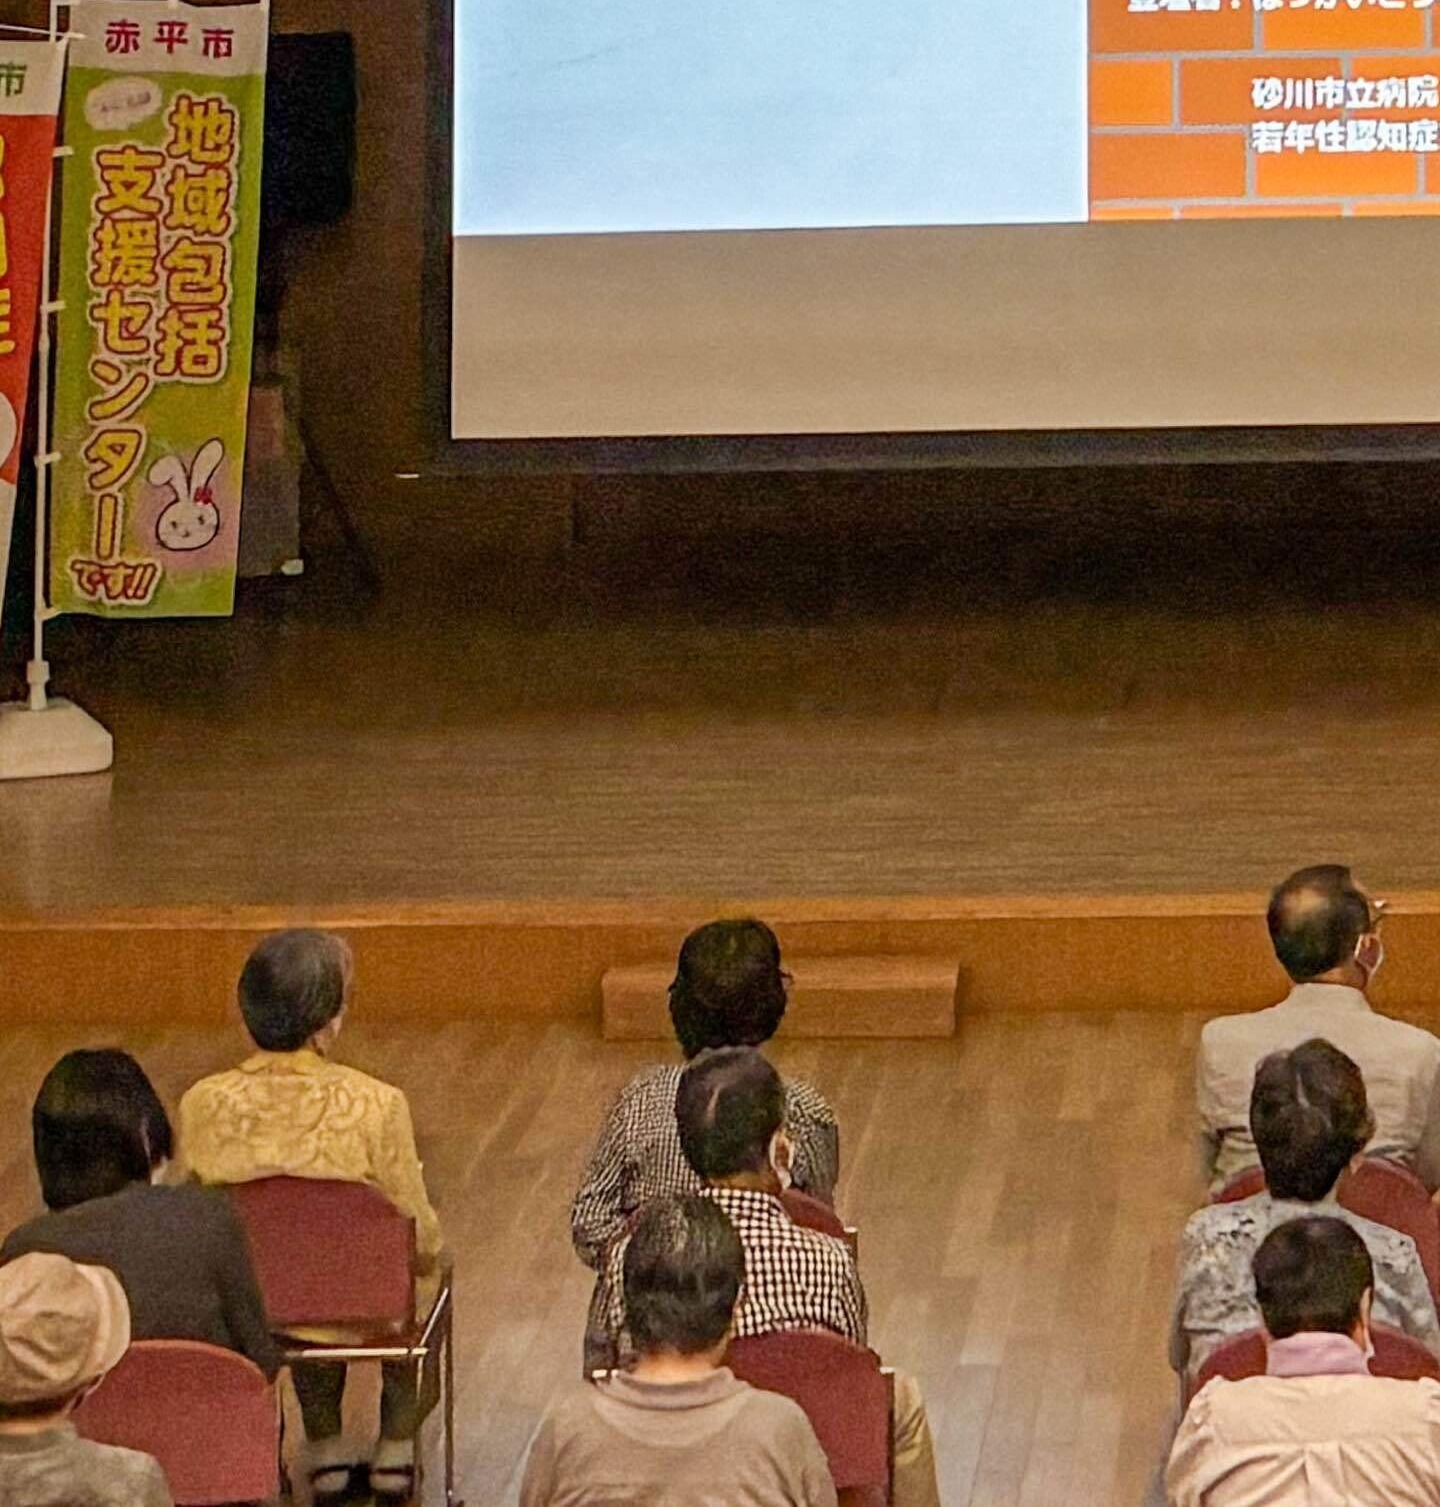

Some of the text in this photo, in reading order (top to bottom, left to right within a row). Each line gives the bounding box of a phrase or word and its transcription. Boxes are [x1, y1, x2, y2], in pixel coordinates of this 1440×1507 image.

[104, 20, 234, 59] 赤平市
[1251, 75, 1439, 110] 砂川市立病院
[154, 93, 236, 378] 地域包括
[83, 145, 165, 560] 支援センター
